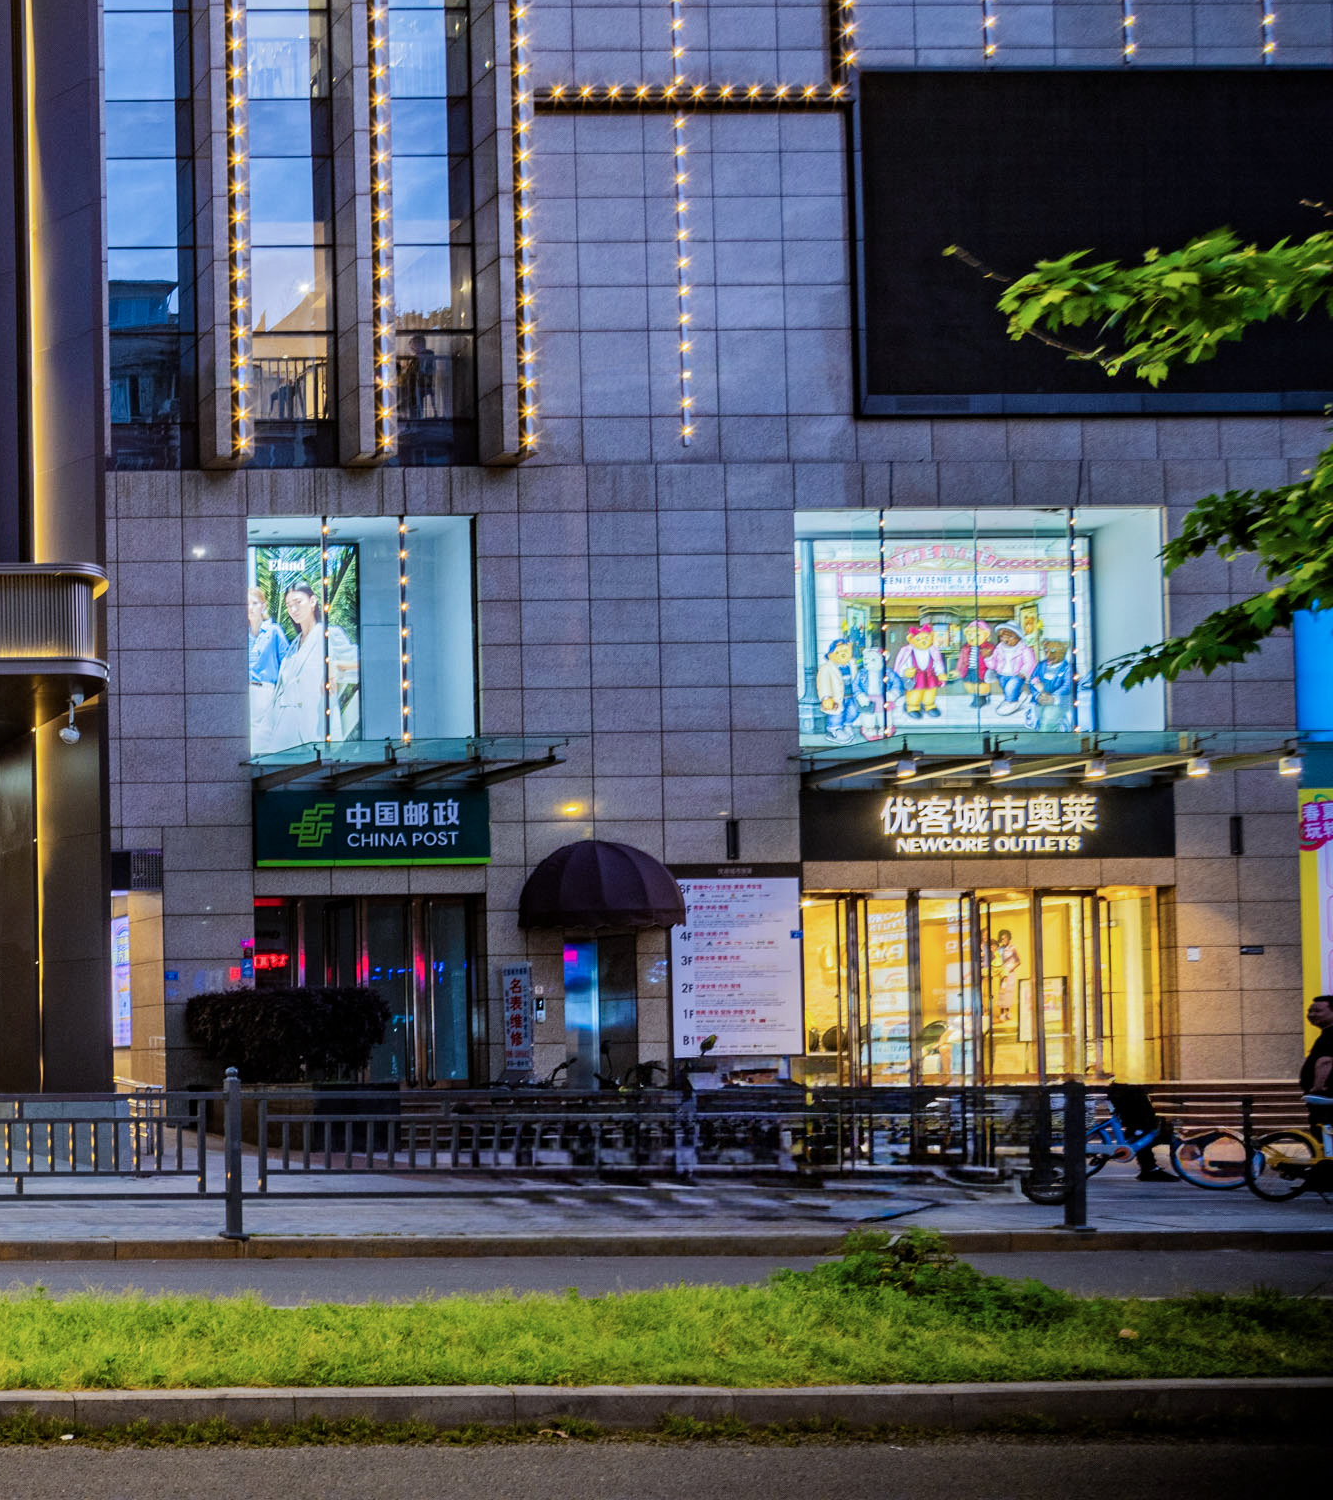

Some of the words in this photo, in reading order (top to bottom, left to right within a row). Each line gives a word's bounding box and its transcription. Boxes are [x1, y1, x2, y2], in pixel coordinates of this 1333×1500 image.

[268, 557, 306, 572] Eland
[345, 798, 461, 830] 中国邮政
[880, 793, 1099, 835] 优客城市奥莱
[347, 832, 408, 848] CHINA
[412, 831, 460, 847] POST
[896, 835, 991, 853] NEWCORE
[994, 835, 1083, 852] OUTLETS
[680, 931, 693, 941] 4F
[681, 956, 693, 966] 3F
[681, 983, 694, 993] 2F
